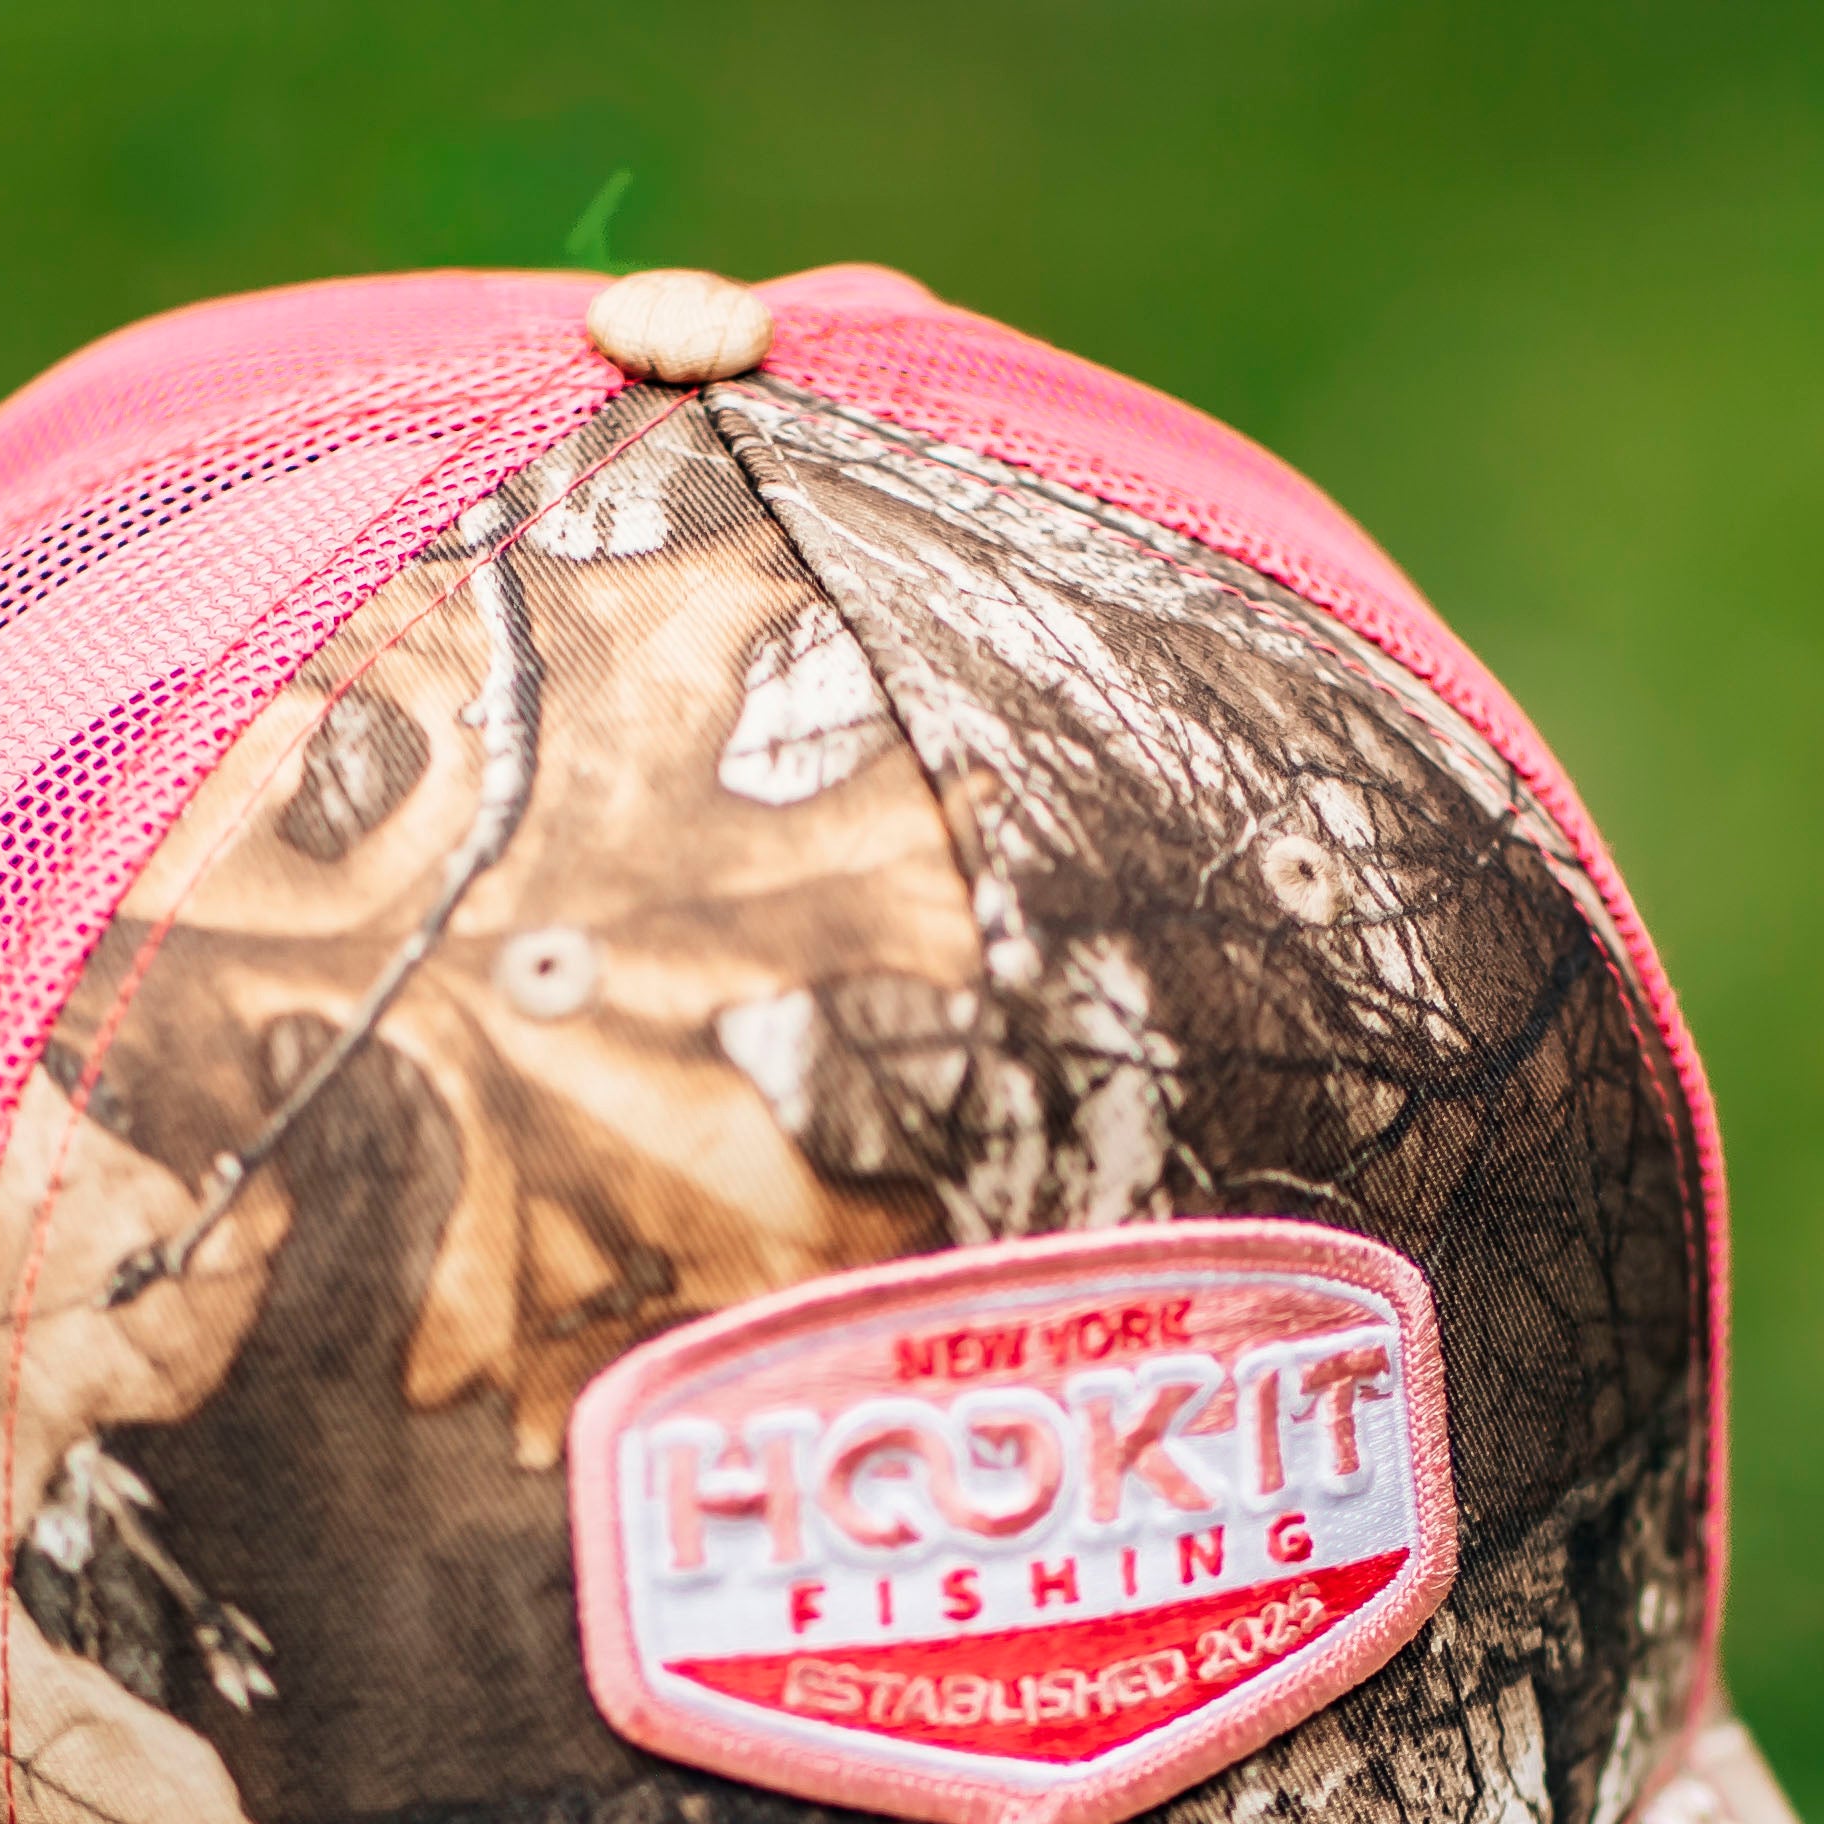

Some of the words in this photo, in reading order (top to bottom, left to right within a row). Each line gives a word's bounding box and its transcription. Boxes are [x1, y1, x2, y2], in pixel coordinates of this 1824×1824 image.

[896, 1326, 1026, 1381] NEW
[1042, 1298, 1193, 1367] YORK
[787, 1511, 1316, 1635] FISHING
[782, 1646, 1188, 1727] ESTABLISHED
[1195, 1581, 1327, 1682] 2025
